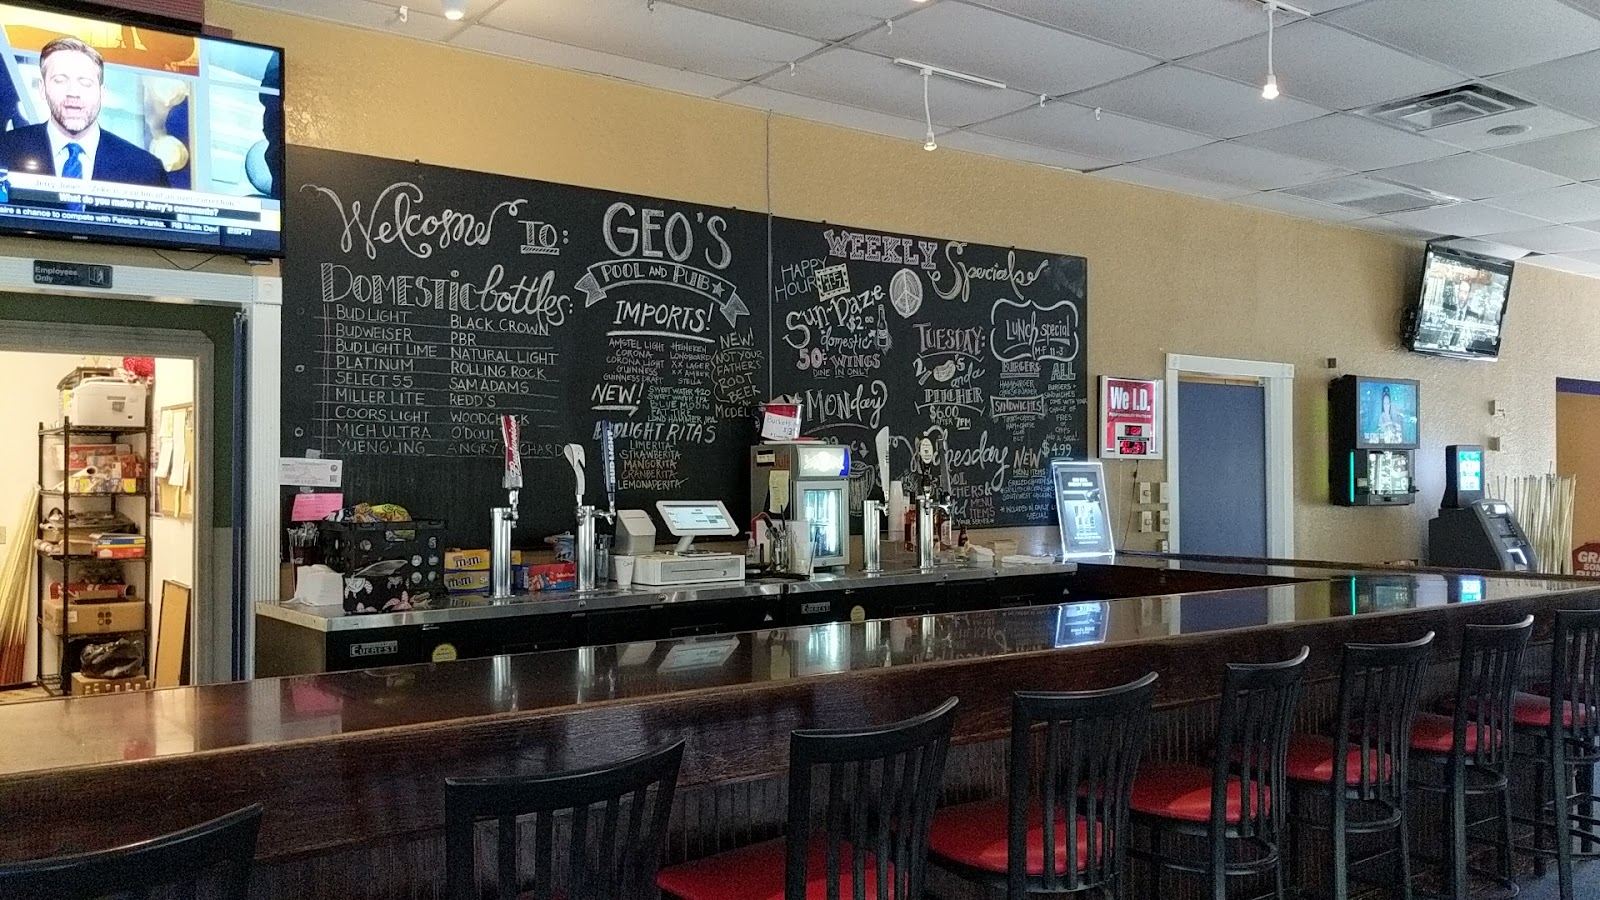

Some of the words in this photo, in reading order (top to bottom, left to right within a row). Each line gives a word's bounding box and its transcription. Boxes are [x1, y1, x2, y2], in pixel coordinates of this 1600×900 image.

[82, 195, 93, 204] do
[94, 197, 110, 206] you
[111, 199, 134, 208] make
[23, 209, 51, 217] chance
[62, 212, 94, 222] compete
[95, 214, 111, 222] with
[299, 182, 528, 260] Welcome
[602, 202, 732, 270] GEO'S
[35, 266, 78, 276] Employees
[781, 256, 827, 282] HAPPY
[823, 228, 938, 270] WEEKLY
[927, 240, 1049, 303] Specials
[35, 274, 53, 283] Only
[601, 262, 645, 283] POOL
[649, 265, 668, 278] AND
[672, 263, 710, 291] PUB
[774, 276, 819, 303] HOUR
[336, 304, 365, 322] BUD
[367, 309, 412, 324] LIGHT
[612, 300, 714, 333] IMPORTS!
[336, 323, 413, 342] BUDWEISER
[451, 314, 493, 331] BLACK
[500, 318, 549, 336] CROWN
[451, 332, 476, 346] PBR
[608, 338, 642, 350] AMSTEL
[644, 341, 664, 352] LIGHT
[720, 327, 754, 349] NEW!
[820, 326, 872, 355] domestic
[913, 322, 986, 355] TUESDAY:
[336, 339, 364, 353] BUD
[365, 342, 401, 356] LIGHT
[406, 345, 437, 357] LIME
[615, 349, 654, 359] CORONA
[669, 351, 711, 361] LONGBOARD
[336, 355, 414, 371] PLATINUM
[451, 349, 512, 362] NATURAL
[517, 351, 559, 365] LIGHT
[606, 356, 641, 365] CORONA
[643, 359, 664, 368] LIGHT
[716, 351, 736, 364] NOT
[737, 350, 765, 361] YOUR
[830, 353, 881, 369] WINGS
[452, 362, 506, 377] ROLLING
[511, 366, 546, 380] ROCK
[616, 365, 658, 376] GUINNESS
[684, 369, 711, 379] AMBER
[686, 362, 711, 371] LAGER
[716, 360, 762, 376] FATHER'S
[812, 368, 831, 377] DINE
[835, 368, 845, 376] IN
[847, 367, 870, 375] ONLY
[1050, 362, 1076, 380] ALL
[335, 371, 387, 387] SELECT
[392, 374, 413, 388] 55
[602, 372, 640, 382] GUINNESS
[678, 378, 702, 386] STELLA
[718, 372, 754, 395] ROOT
[449, 378, 479, 391] SAM
[480, 379, 529, 394] ADAMS
[591, 383, 644, 404] NEW!
[1047, 383, 1072, 391] BURGERS
[336, 388, 385, 403] MILLER
[391, 392, 425, 405] LITE
[450, 394, 496, 407] REDD'S
[727, 385, 761, 404] BEER
[924, 386, 983, 404] PITCHER
[1110, 386, 1130, 410] We
[1132, 387, 1151, 411] I.D.
[650, 400, 678, 409] BLUE
[680, 401, 710, 410] MOON
[651, 408, 667, 417] FAT
[670, 408, 694, 418] TIRE
[929, 405, 960, 420] $6.00
[995, 400, 1041, 412] SANDWICHES
[335, 406, 386, 421] COORS
[390, 408, 430, 423] LIGHT
[1055, 414, 1072, 422] FRIES
[336, 423, 376, 438] MICH
[381, 425, 431, 439] ULTRA
[665, 423, 717, 445] RITAS
[1055, 426, 1071, 434] CHIPS
[337, 438, 425, 454] YUENGLING
[447, 442, 497, 456] ANGRY
[629, 440, 675, 451] LIMERITA
[1041, 440, 1072, 457] $4.99
[619, 449, 682, 460] STRAWBERITA
[1013, 446, 1041, 468] NEW
[623, 460, 678, 470] MANGORITA
[621, 470, 678, 480] CRANBERITA
[617, 478, 688, 491] LEMONADERITA
[970, 497, 993, 507] MENU
[969, 507, 996, 519] ITEMS
